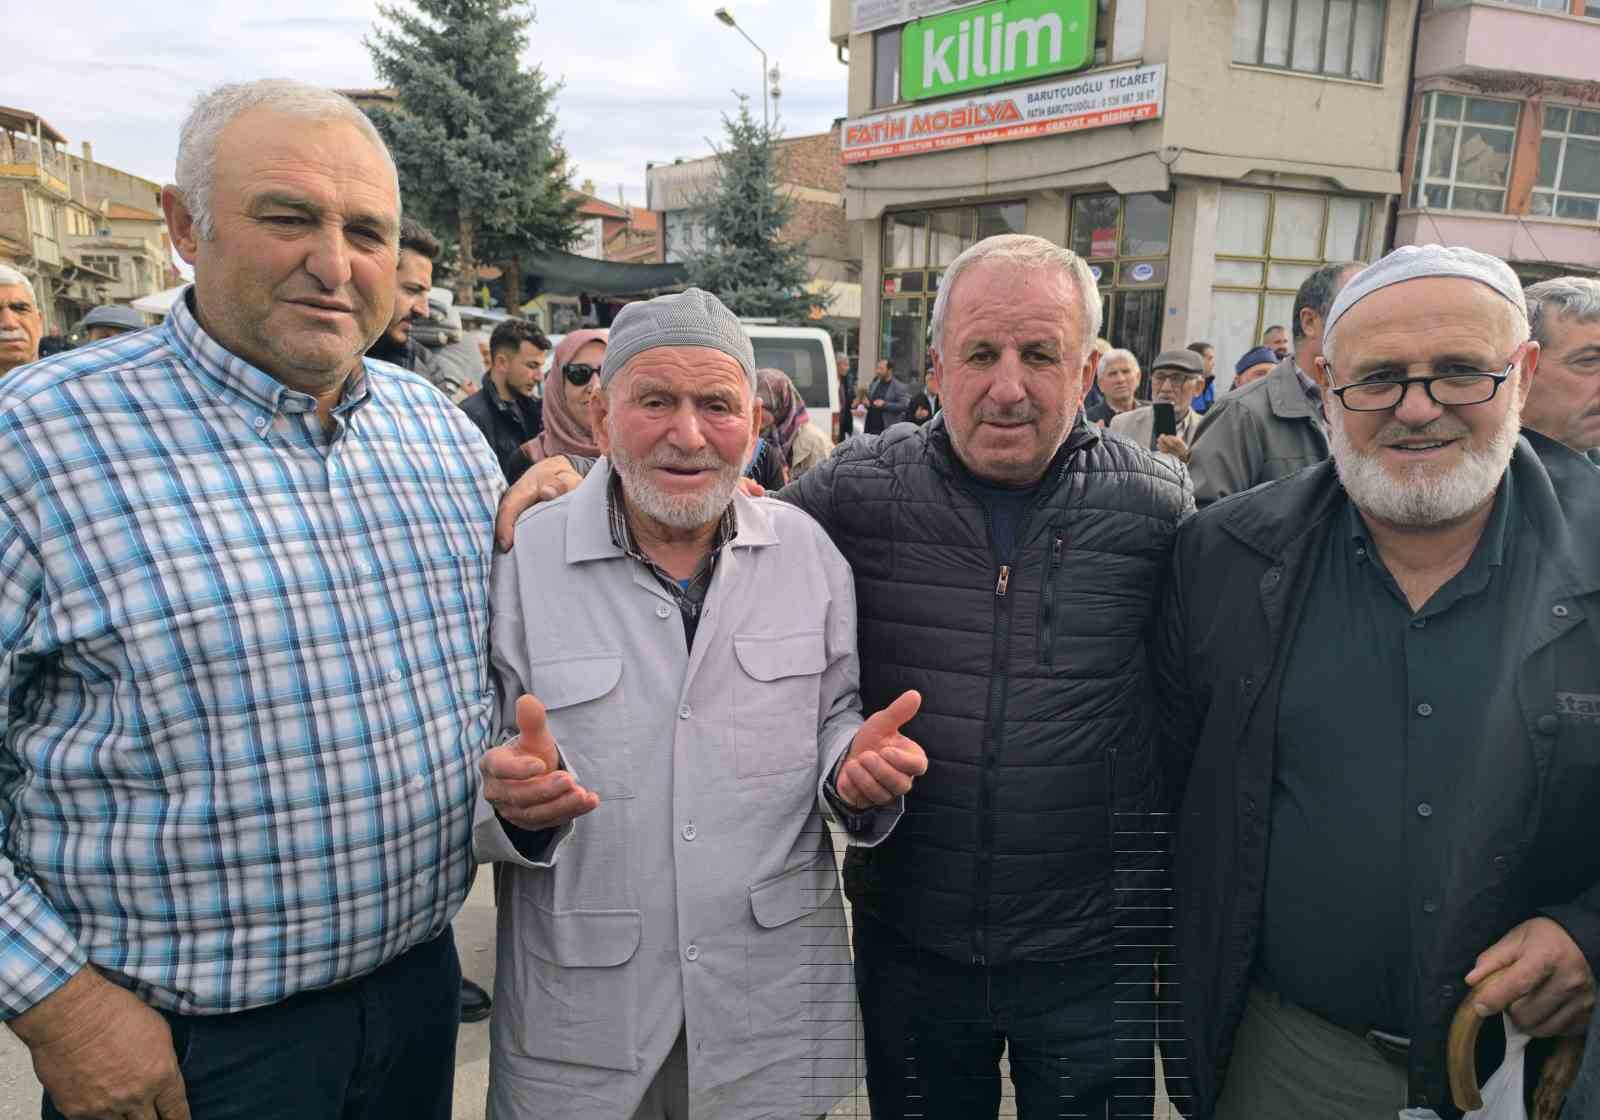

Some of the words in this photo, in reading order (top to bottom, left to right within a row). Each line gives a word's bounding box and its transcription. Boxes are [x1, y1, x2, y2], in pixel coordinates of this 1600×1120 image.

[922, 11, 1062, 89] kilim
[1027, 81, 1103, 104] BARUTÇUOĞLU
[1110, 71, 1156, 89] TİCARET
[847, 116, 905, 145] FATİH
[911, 98, 1023, 134] MOBİLYA
